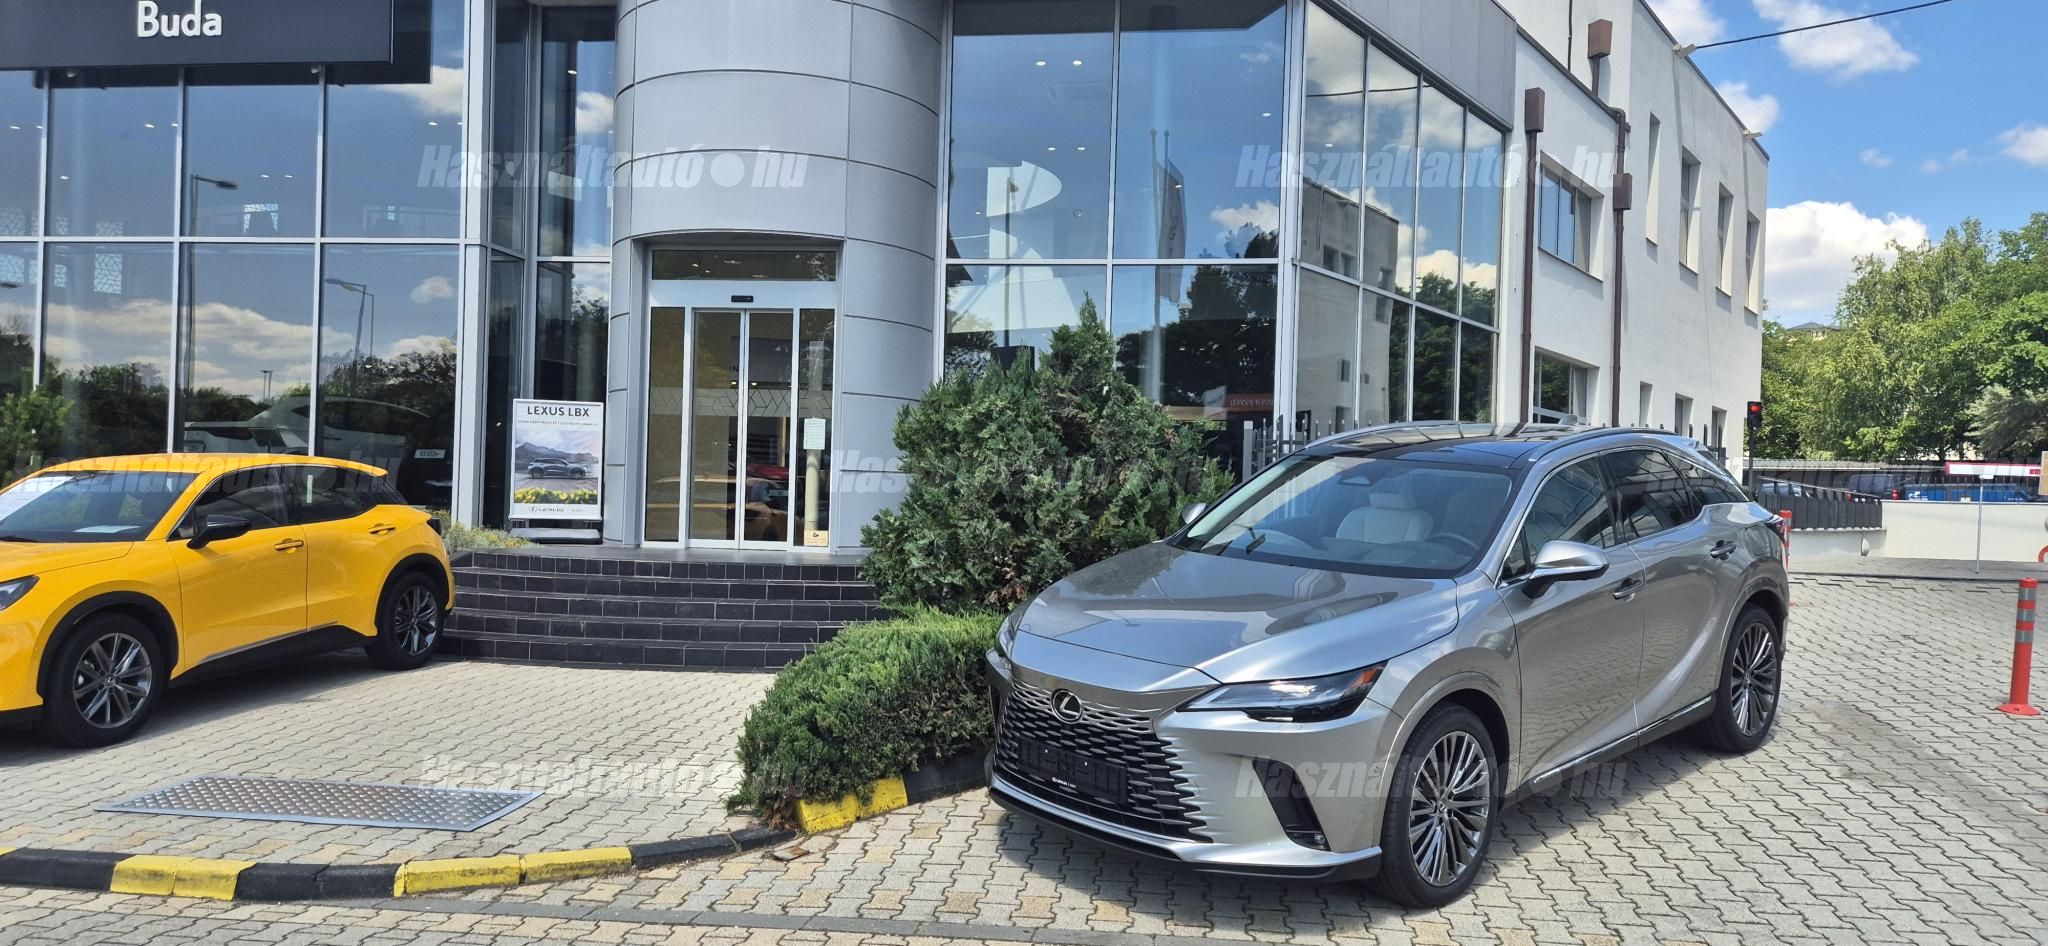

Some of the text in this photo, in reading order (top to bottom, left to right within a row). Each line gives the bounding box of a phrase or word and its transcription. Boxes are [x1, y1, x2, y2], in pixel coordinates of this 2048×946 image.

[137, 0, 222, 37] Buda
[527, 405, 590, 417] LEXUS LBX
